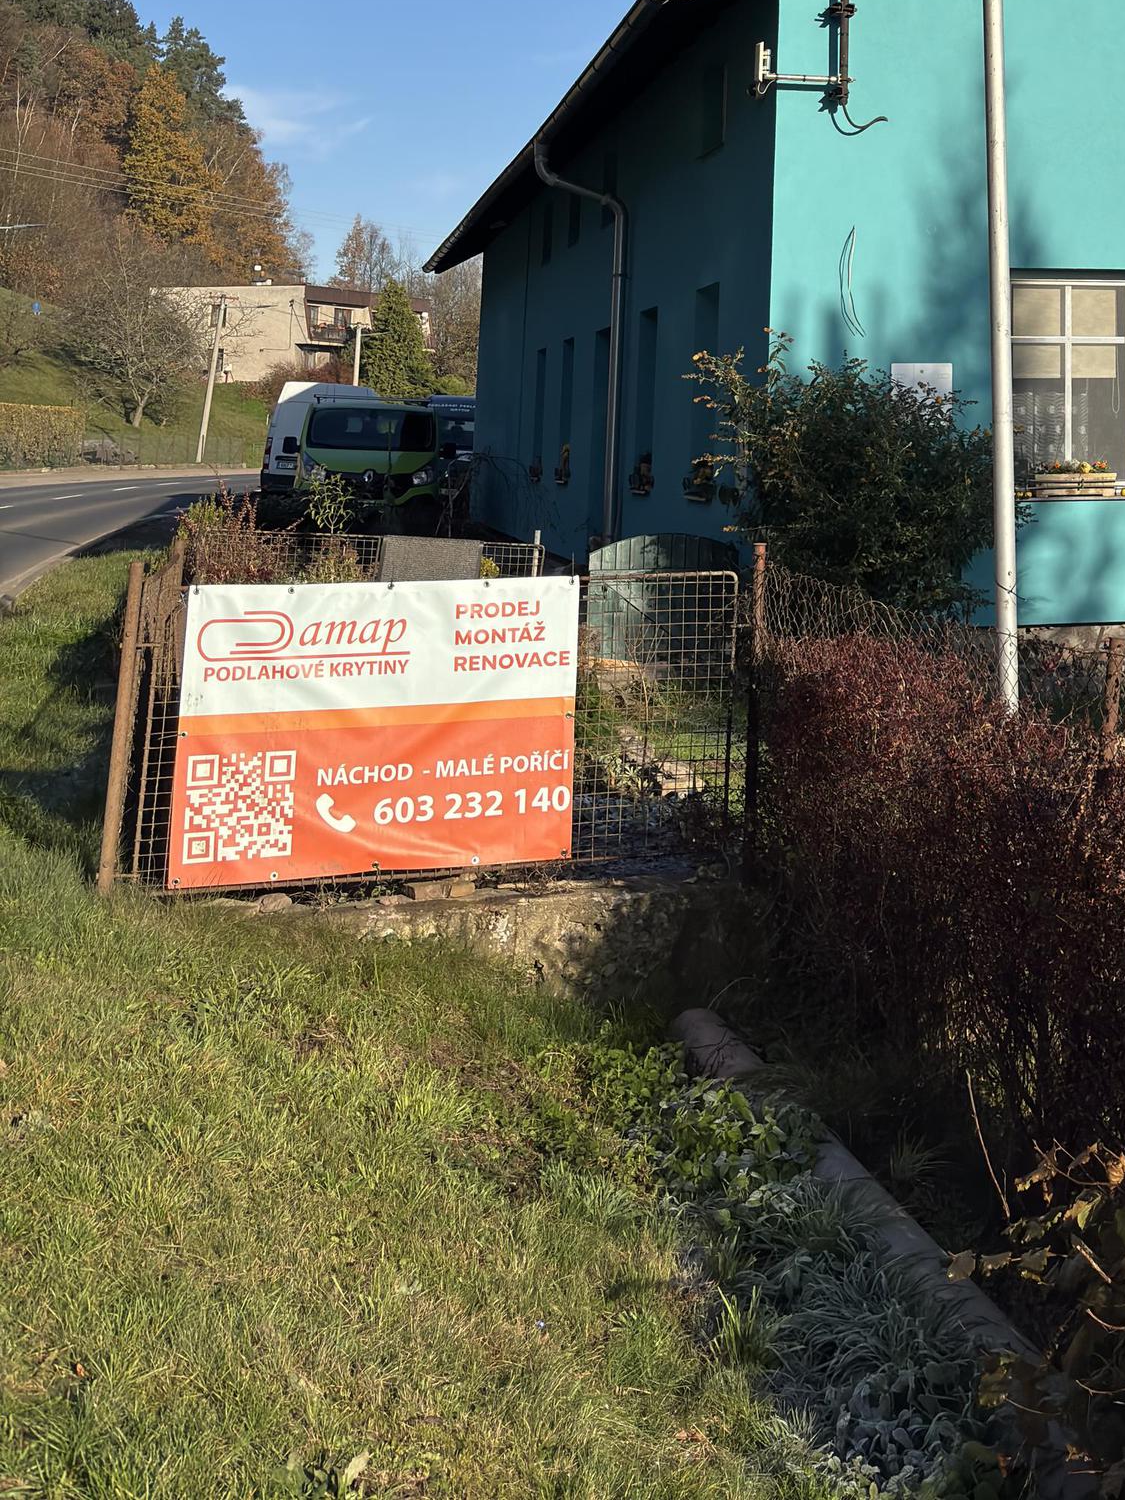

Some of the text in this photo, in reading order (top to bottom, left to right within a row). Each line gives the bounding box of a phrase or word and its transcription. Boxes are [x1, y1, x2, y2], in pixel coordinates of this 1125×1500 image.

[455, 600, 541, 620] PRODEJ
[454, 620, 546, 646] MONTÁŽ
[203, 658, 410, 683] PODLAHOVÉ KRYTINY
[453, 650, 571, 672] RENOVACE
[316, 763, 413, 787] NÁCHOD
[435, 753, 495, 779] MALÉ
[499, 749, 570, 774] POŘÍČÍ
[373, 785, 571, 825] 603 232 140
